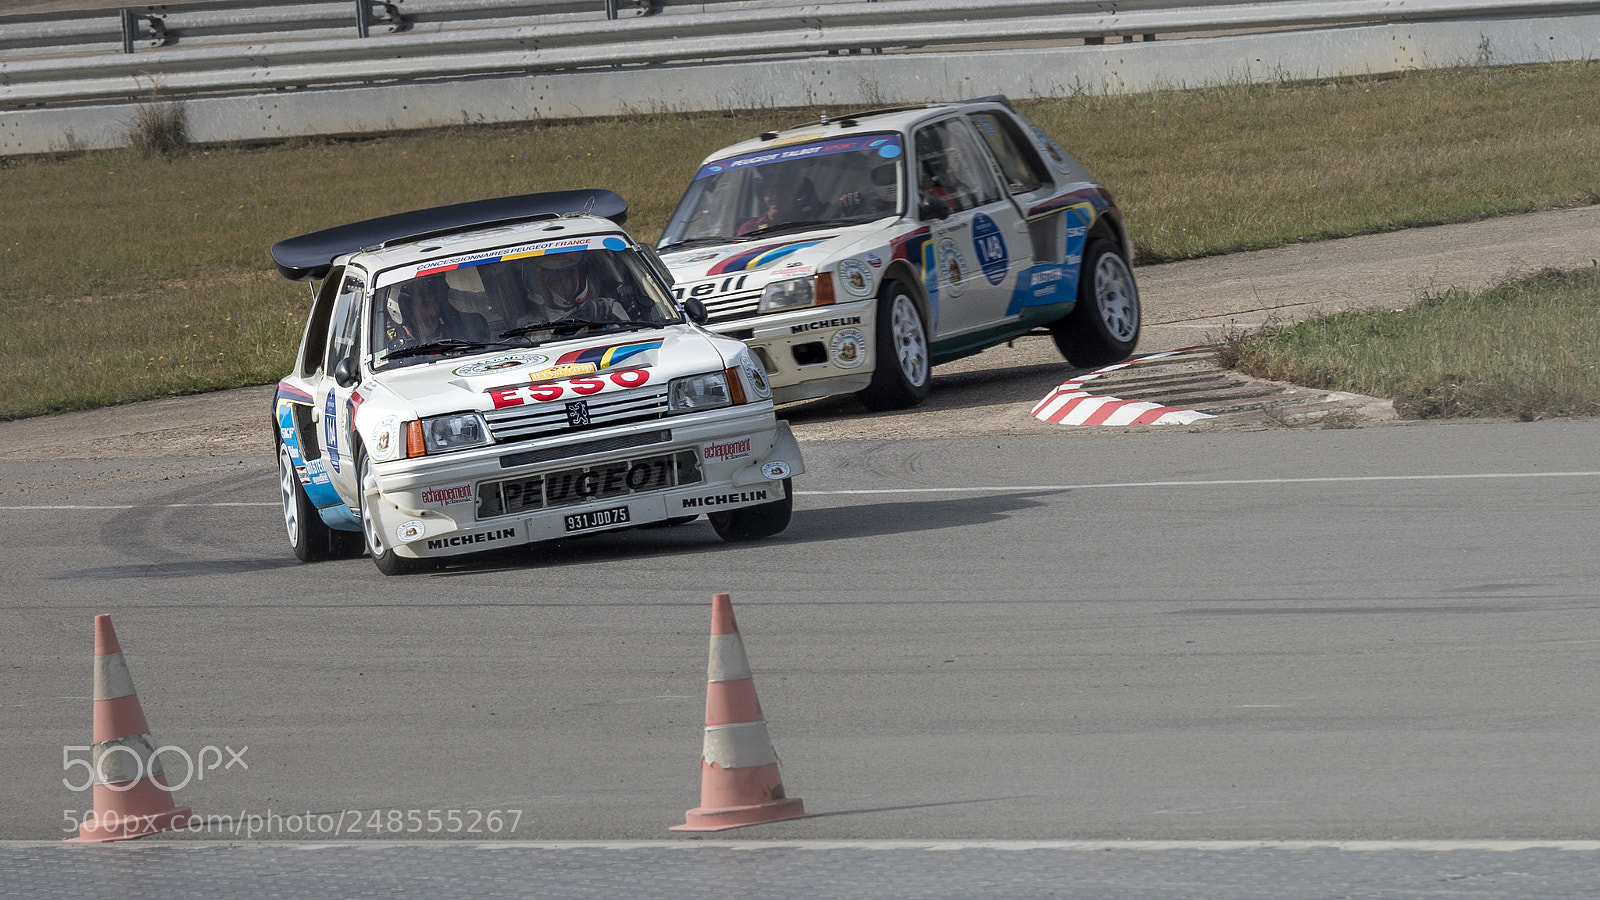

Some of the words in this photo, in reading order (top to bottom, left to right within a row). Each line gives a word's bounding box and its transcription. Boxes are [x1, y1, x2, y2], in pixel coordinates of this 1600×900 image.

[730, 153, 780, 168] PEUGEOT
[781, 146, 823, 159] TALBOT
[416, 249, 510, 271] CONCESSIONNAIRES
[510, 242, 555, 255] PEUGEOT
[555, 238, 592, 247] FRANCE
[791, 316, 861, 334] MICHELIN
[490, 369, 650, 409] ESSO
[703, 437, 751, 461] echappement
[421, 483, 473, 506] echappement
[496, 460, 680, 513] PEUGEOT
[682, 490, 767, 508] MICHELIN
[567, 517, 588, 529] 931
[591, 511, 610, 526] JDD
[612, 507, 627, 521] 75
[428, 527, 516, 550] MICHELIN
